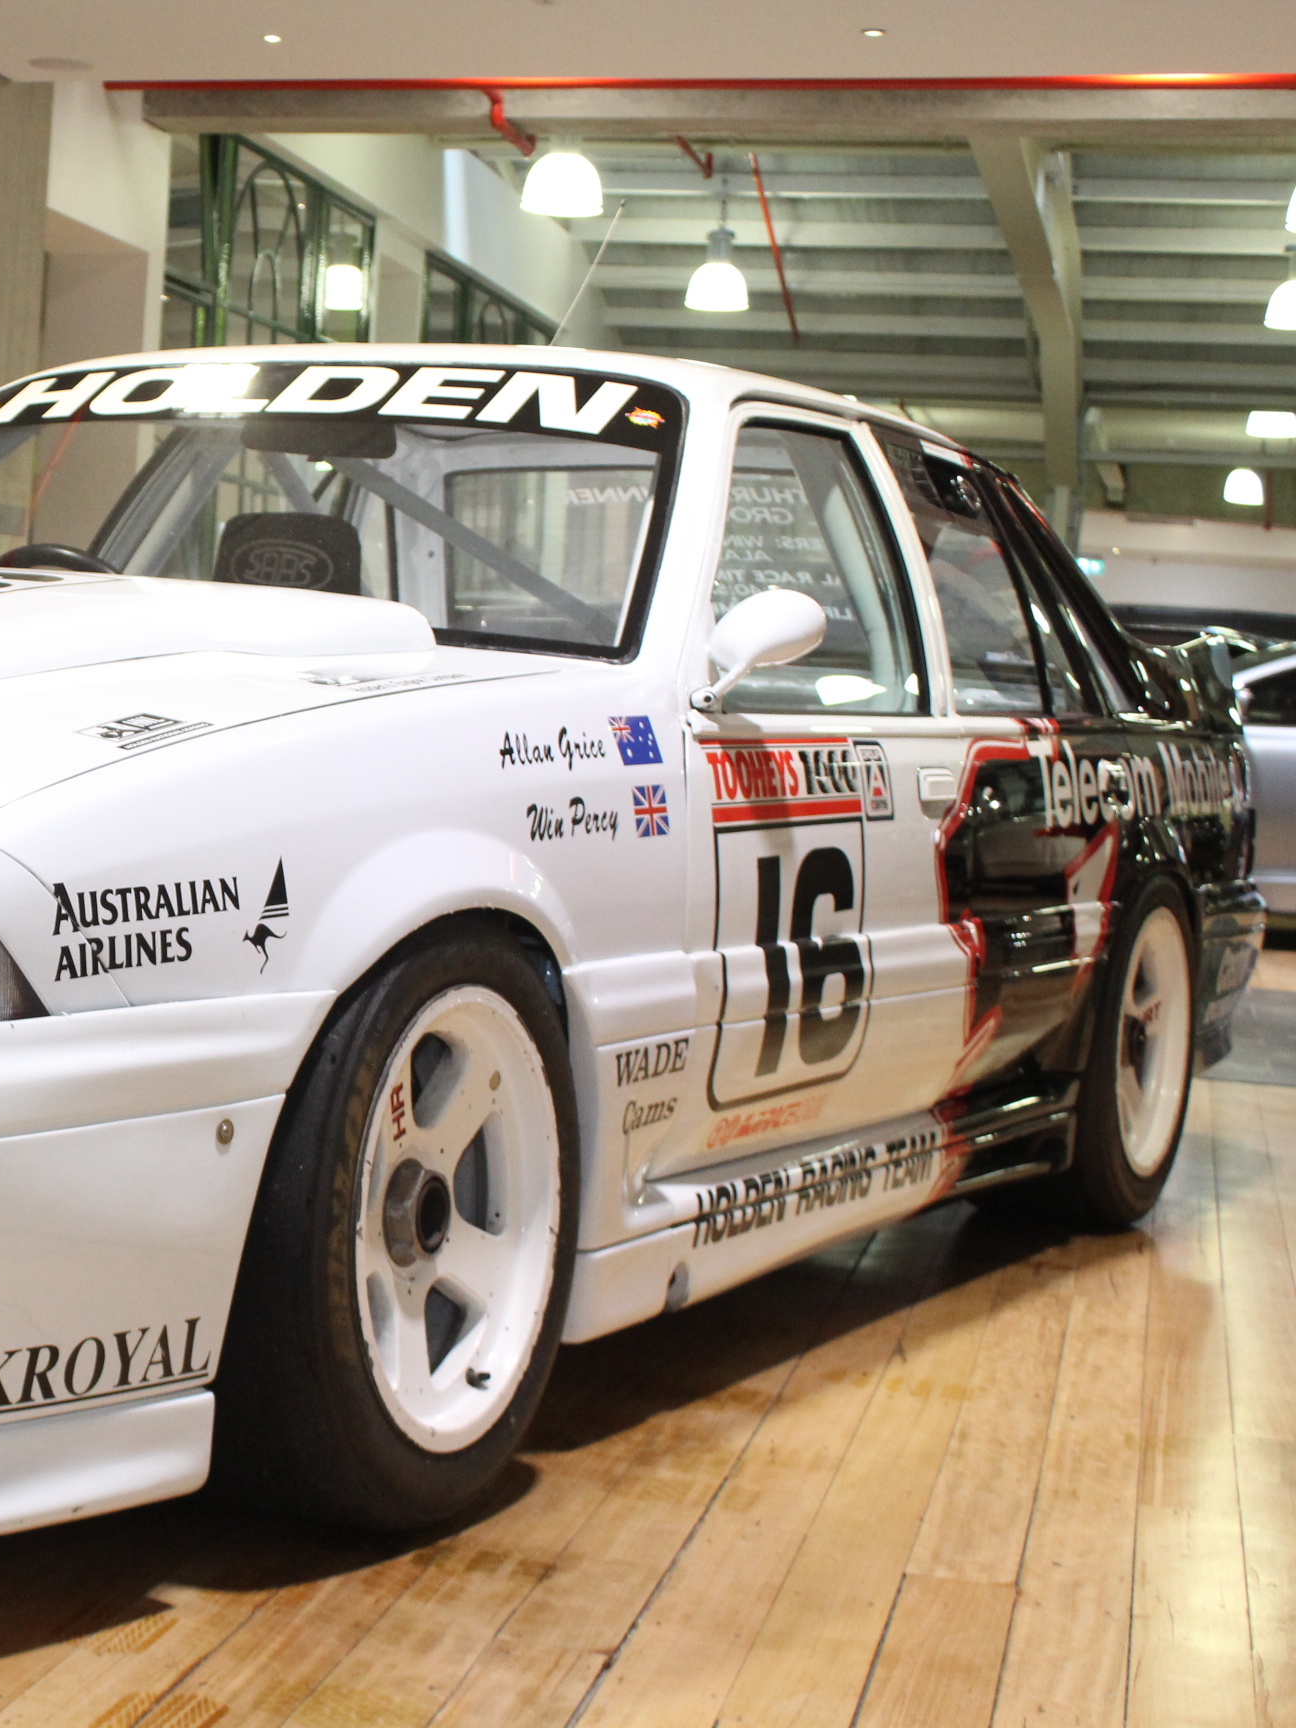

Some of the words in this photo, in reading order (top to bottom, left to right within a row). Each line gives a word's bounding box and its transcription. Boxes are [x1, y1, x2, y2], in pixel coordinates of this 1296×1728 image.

[499, 731, 554, 769] Allan
[558, 726, 605, 771] Grice
[706, 750, 798, 801] TOOHEYS
[1027, 736, 1162, 829] Telecom
[526, 803, 564, 842] Win
[569, 796, 618, 840] Percy
[54, 926, 192, 982] AIRLINES
[754, 846, 864, 1077] 16
[615, 1037, 690, 1088] WADE
[622, 1097, 678, 1135] Cams
[692, 1168, 791, 1249] HOLDEN
[794, 1143, 877, 1216] RACING
[881, 1130, 938, 1193] TEAM
